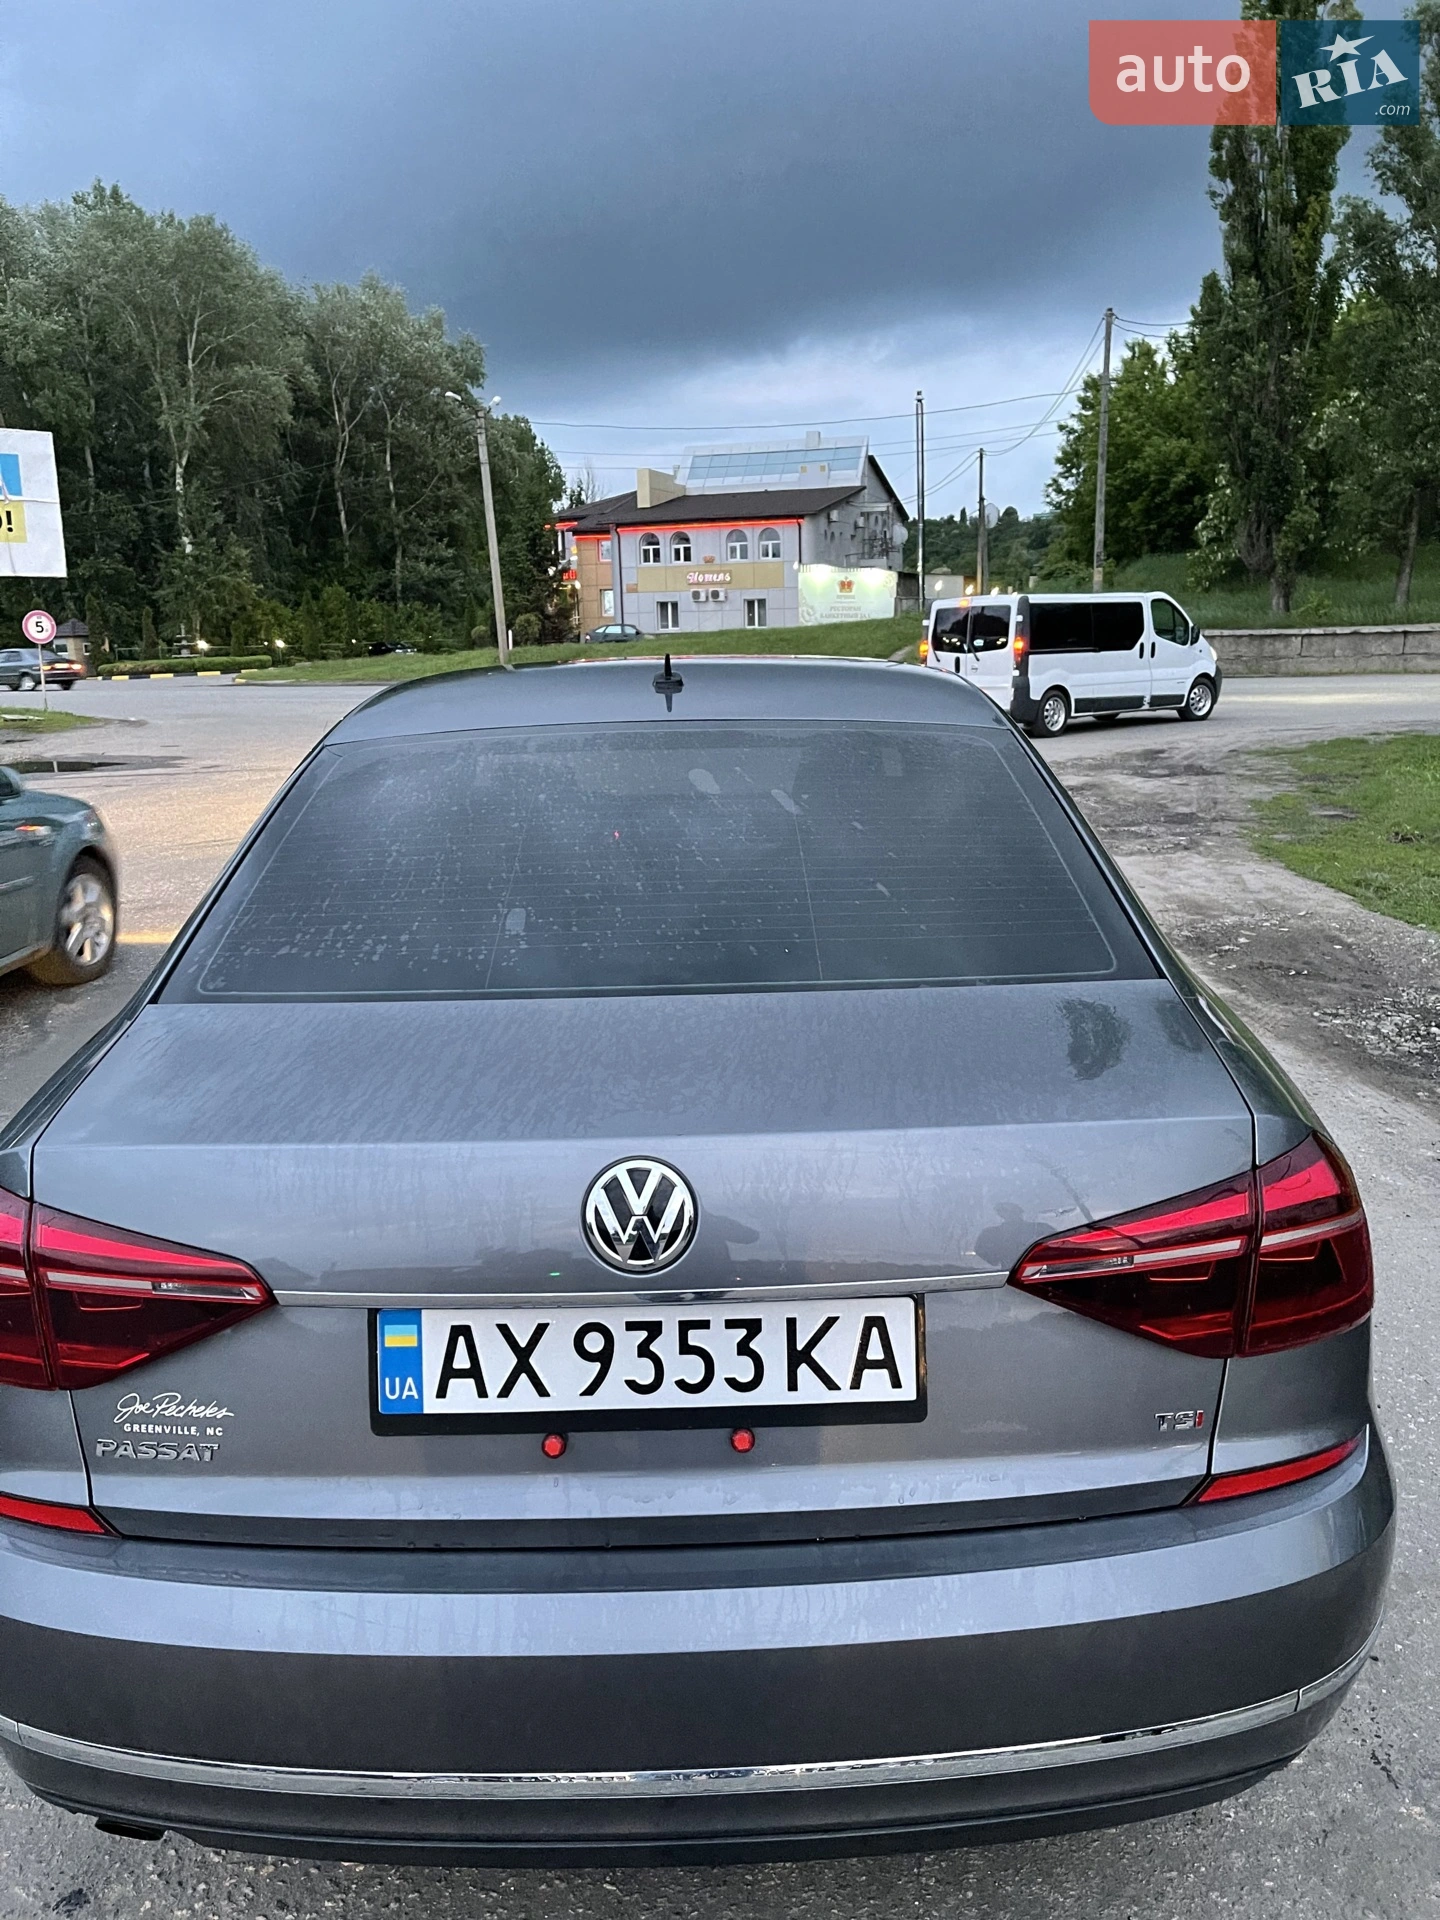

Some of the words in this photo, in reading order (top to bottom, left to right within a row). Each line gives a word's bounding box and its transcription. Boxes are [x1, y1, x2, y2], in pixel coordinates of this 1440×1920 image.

[35, 621, 44, 633] 5
[435, 1323, 551, 1399] AX
[572, 1317, 765, 1397] 9353
[786, 1315, 903, 1391] KA
[385, 1377, 419, 1400] UA
[114, 1392, 154, 1423] Joe
[123, 1423, 200, 1437] GREENVILLE,
[206, 1427, 223, 1436] NC
[1154, 1410, 1204, 1431] TSI
[96, 1438, 219, 1462] PASSAT
